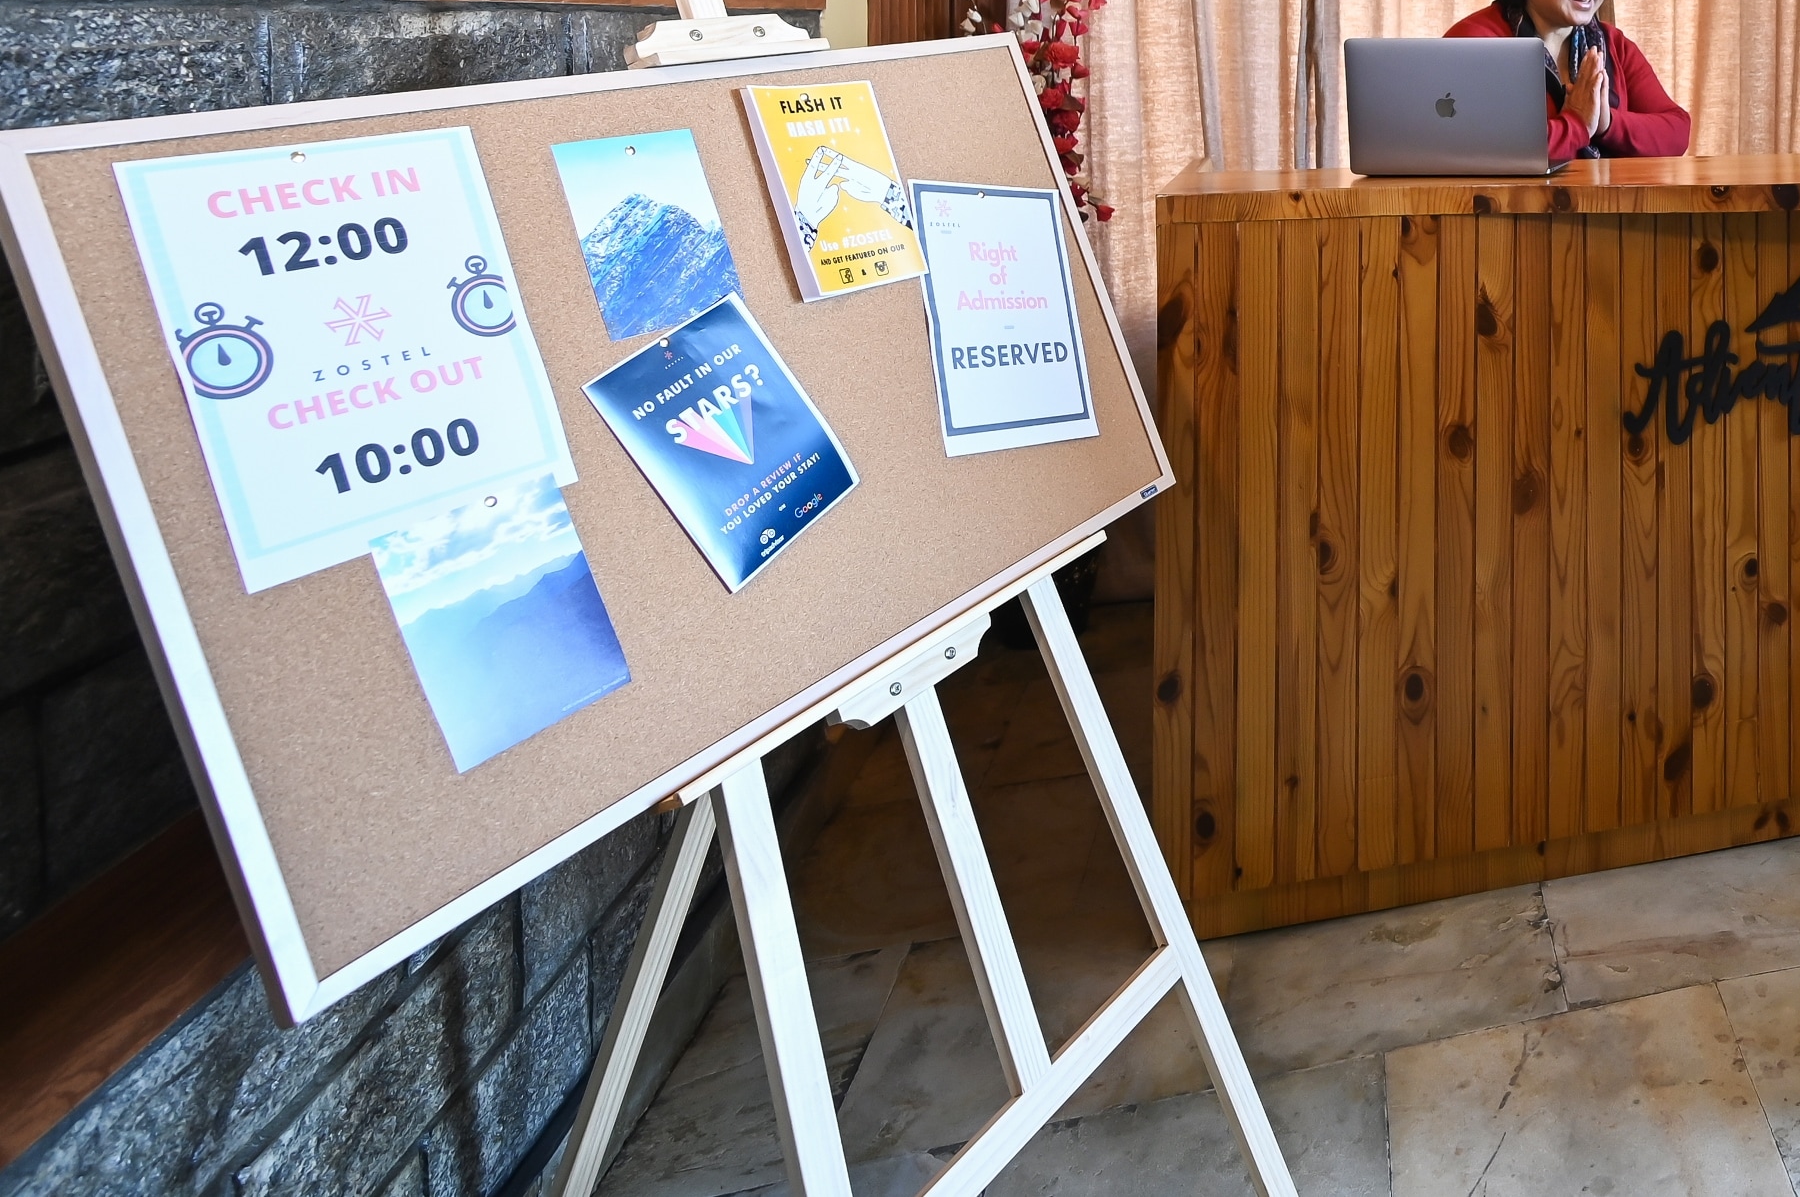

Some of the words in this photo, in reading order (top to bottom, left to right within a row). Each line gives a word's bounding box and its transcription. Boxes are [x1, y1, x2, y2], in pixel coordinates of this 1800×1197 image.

[779, 98, 826, 115] FLASH
[830, 96, 844, 111] IT
[786, 119, 826, 138] HASH
[206, 174, 362, 219] CHECK
[372, 166, 422, 198] IN
[238, 216, 409, 276] 12:00
[819, 239, 839, 253] Use
[842, 228, 893, 249] #ZOSTEL
[820, 258, 832, 267] AND
[832, 255, 844, 265] GET
[844, 250, 876, 262] FEATURED
[877, 247, 889, 256] ON
[890, 243, 906, 253] OUR
[968, 241, 1018, 267] Right
[989, 265, 1009, 286] of
[956, 290, 1049, 312] Admission
[312, 346, 432, 383] ZOSTEL
[951, 341, 1069, 370] RESERVED
[266, 376, 402, 431] CHECK
[409, 356, 486, 394] OUT
[632, 400, 655, 421] NO
[655, 373, 694, 406] FAULT
[695, 362, 713, 379] IN
[713, 343, 742, 367] OUR
[665, 363, 765, 444] STARS?
[315, 417, 480, 494] 10:00
[720, 516, 742, 536] YOU
[742, 491, 773, 519] LOVED
[771, 471, 798, 494] YOUR
[797, 452, 821, 477] STAY!
[724, 492, 751, 517] DROP
[752, 486, 761, 497] A
[760, 460, 793, 490] REVIEW
[793, 452, 803, 465] IF
[794, 492, 824, 519] Google
[760, 534, 785, 558] tripadvisor
